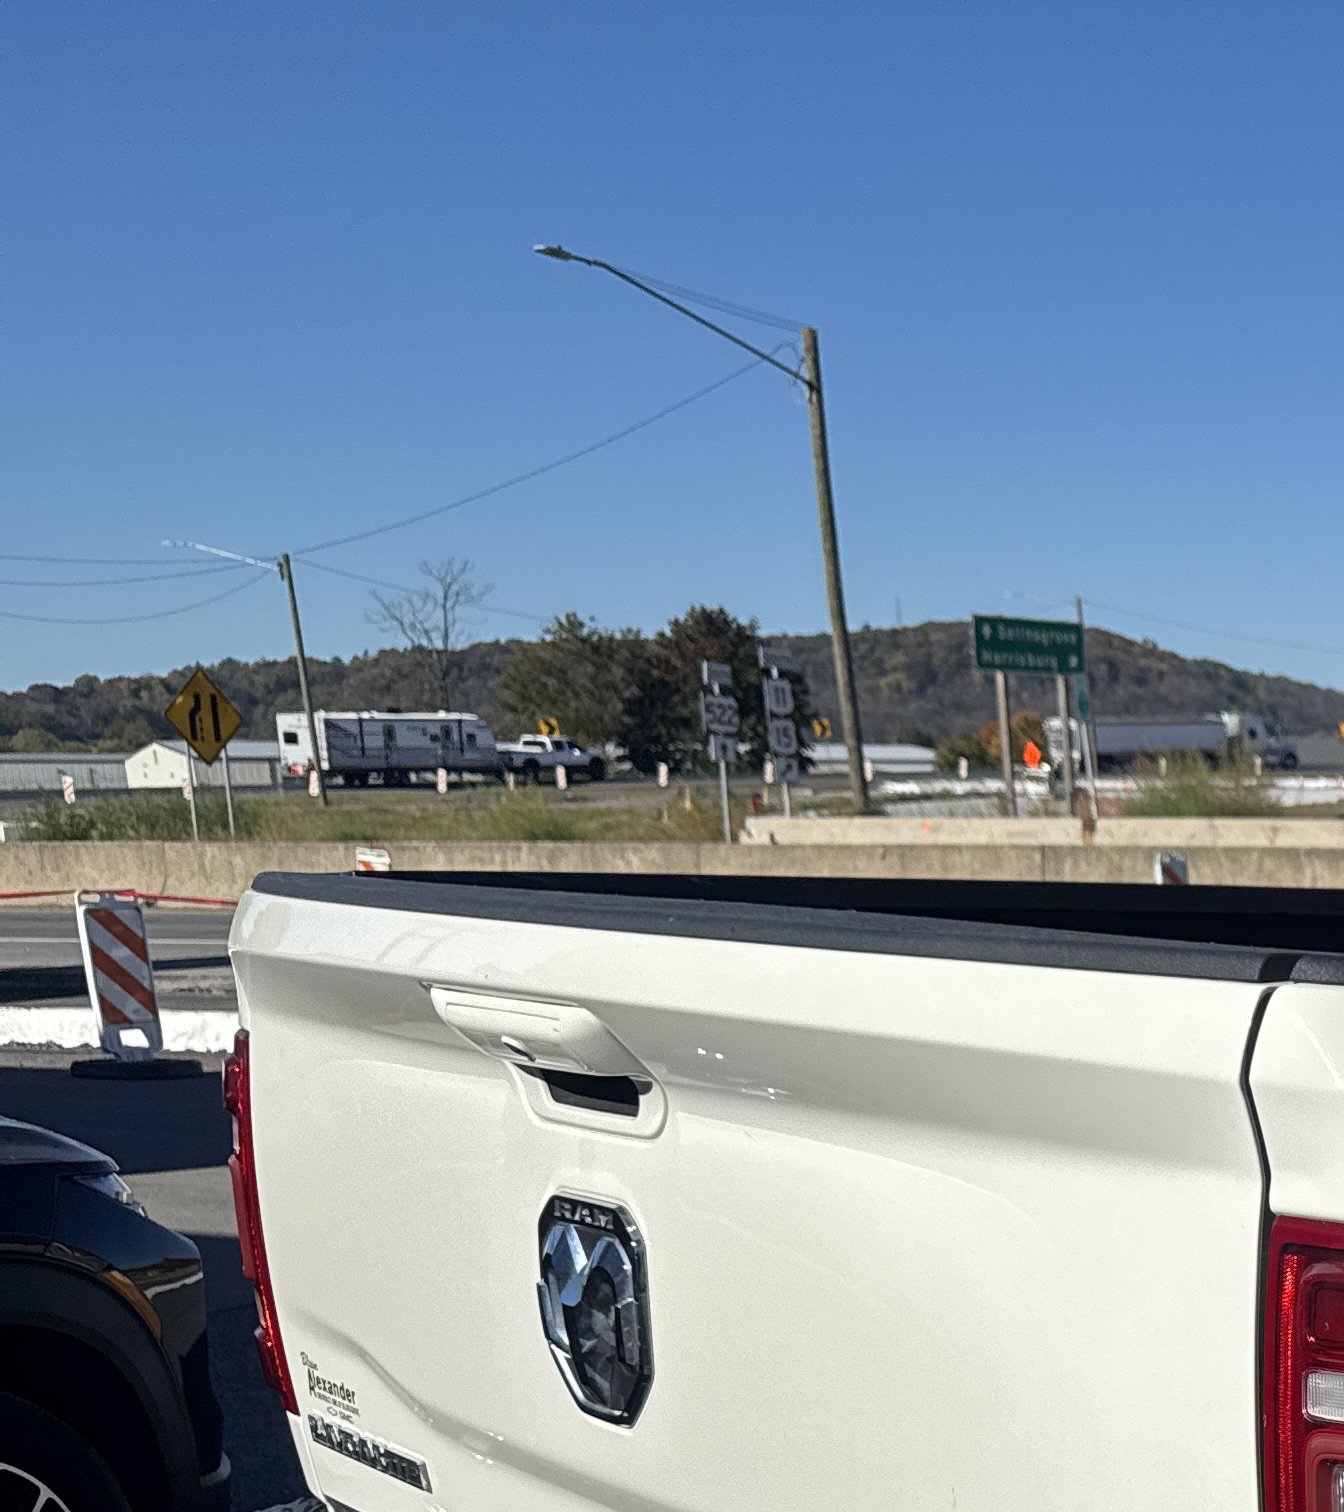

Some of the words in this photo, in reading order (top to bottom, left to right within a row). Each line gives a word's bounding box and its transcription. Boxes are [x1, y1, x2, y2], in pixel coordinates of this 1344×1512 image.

[704, 702, 738, 726] 522
[553, 1199, 615, 1230] RAM
[307, 1367, 356, 1405] Alexander
